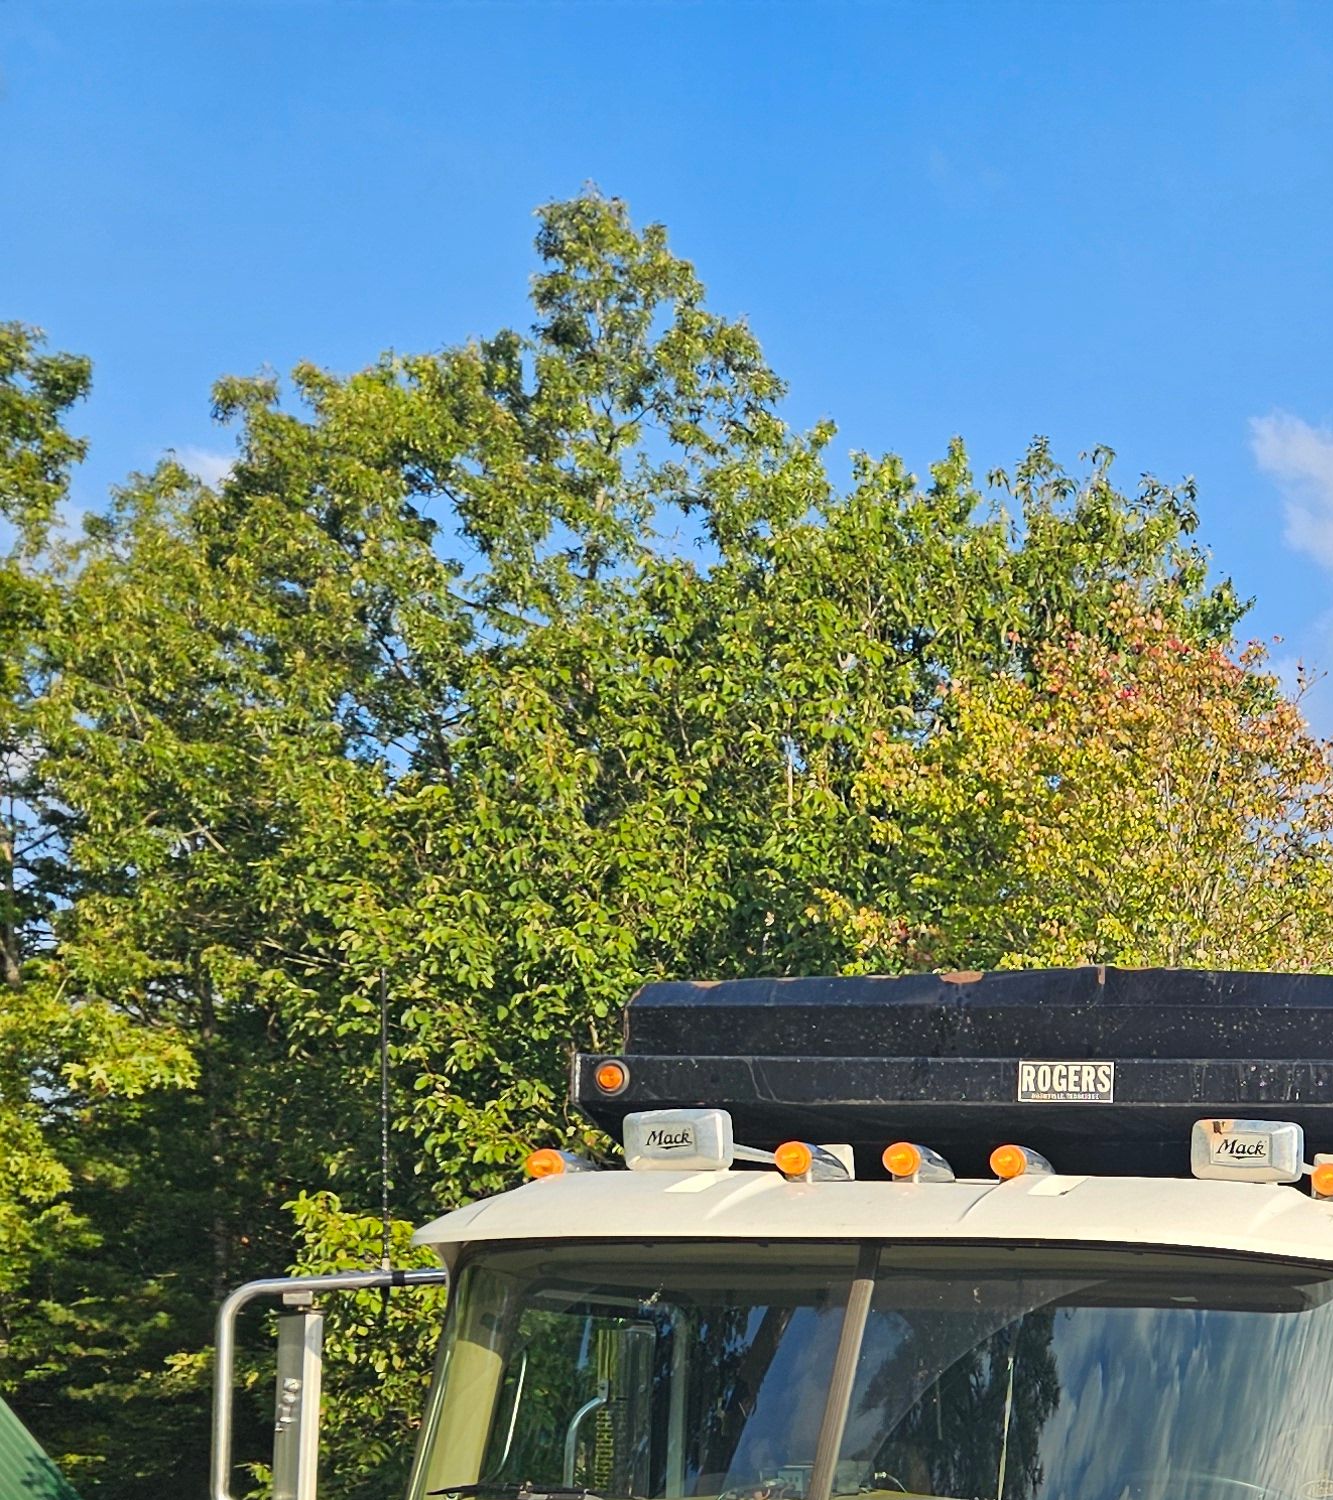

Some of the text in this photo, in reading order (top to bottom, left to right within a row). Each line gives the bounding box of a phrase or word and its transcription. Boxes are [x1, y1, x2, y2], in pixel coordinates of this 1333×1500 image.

[1021, 1064, 1111, 1093] ROGERS
[645, 1128, 693, 1149] Mack
[1216, 1138, 1267, 1160] Mack
